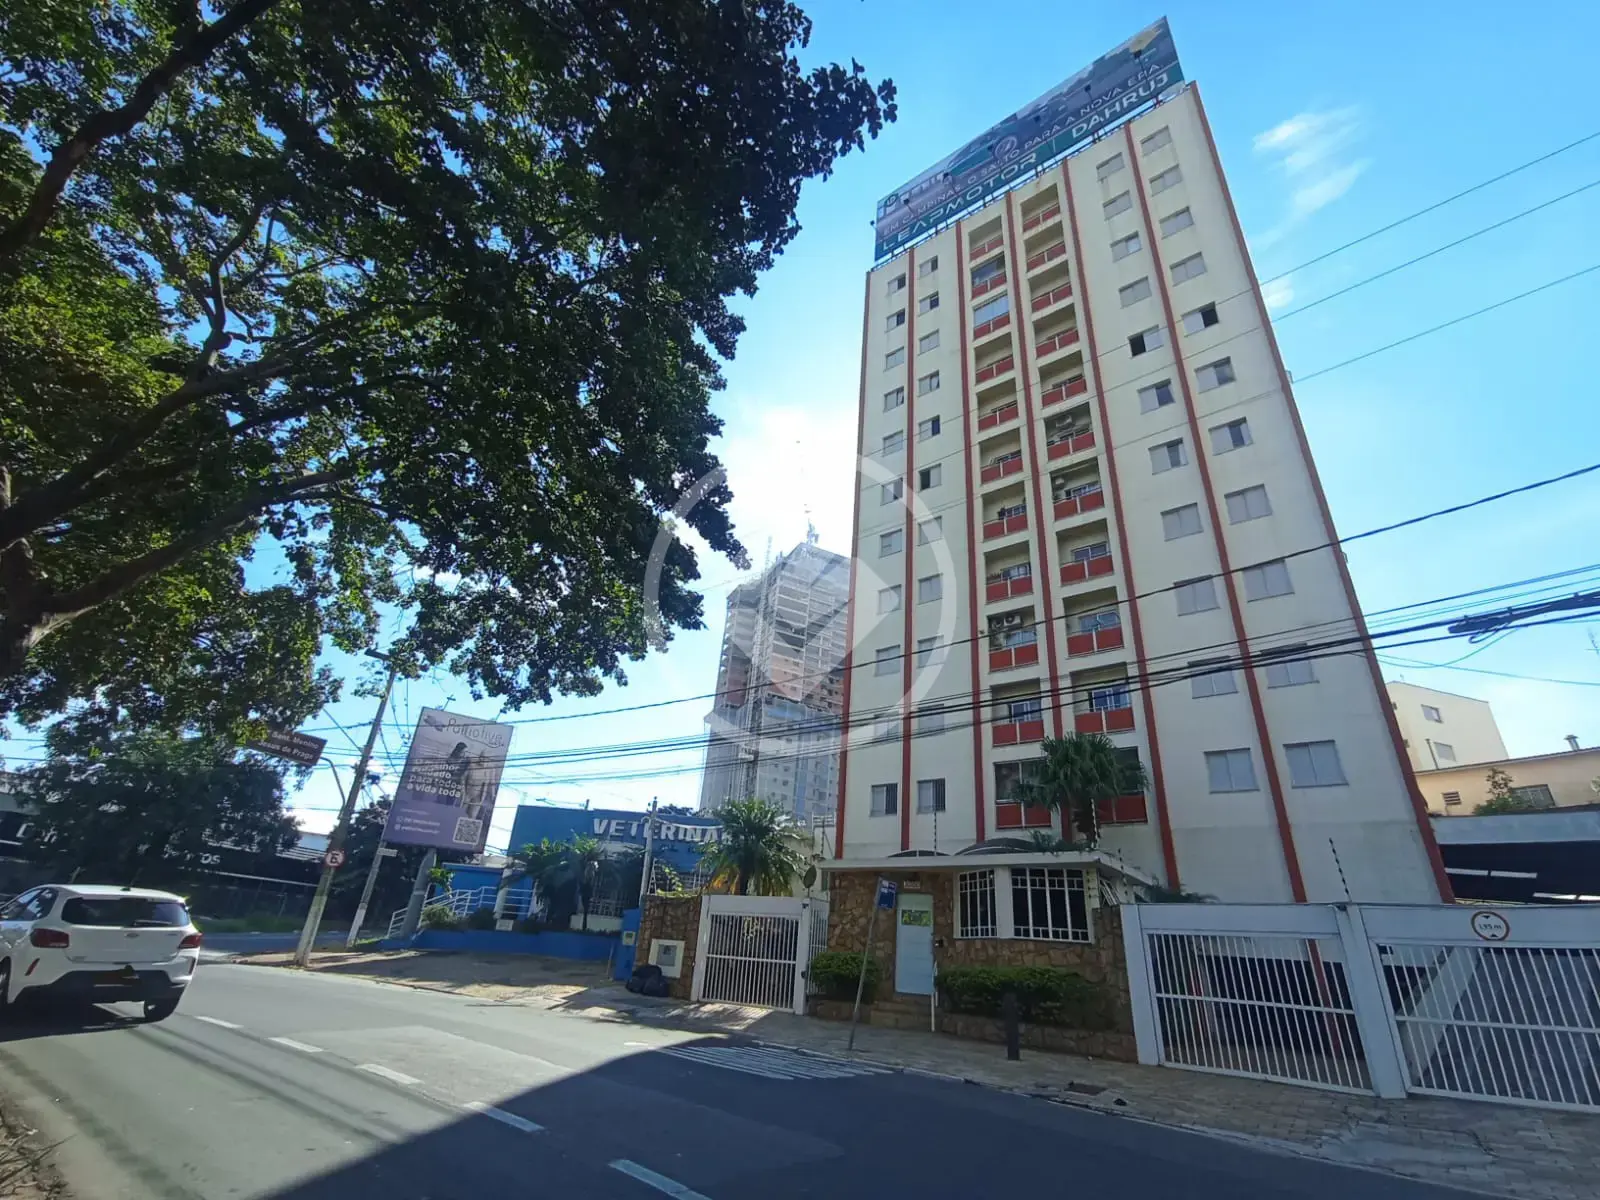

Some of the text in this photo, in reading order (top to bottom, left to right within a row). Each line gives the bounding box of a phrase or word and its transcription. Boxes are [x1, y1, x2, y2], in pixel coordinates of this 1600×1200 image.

[1024, 124, 1061, 150] PARA
[1065, 116, 1075, 125] A
[1079, 87, 1123, 117] NOVA
[1127, 63, 1161, 88] ERA
[1072, 72, 1169, 139] DAHRUJ
[883, 152, 1037, 251] LEAPMOTOR
[409, 775, 433, 784] para
[415, 783, 437, 794] vida
[438, 787, 461, 798] toda
